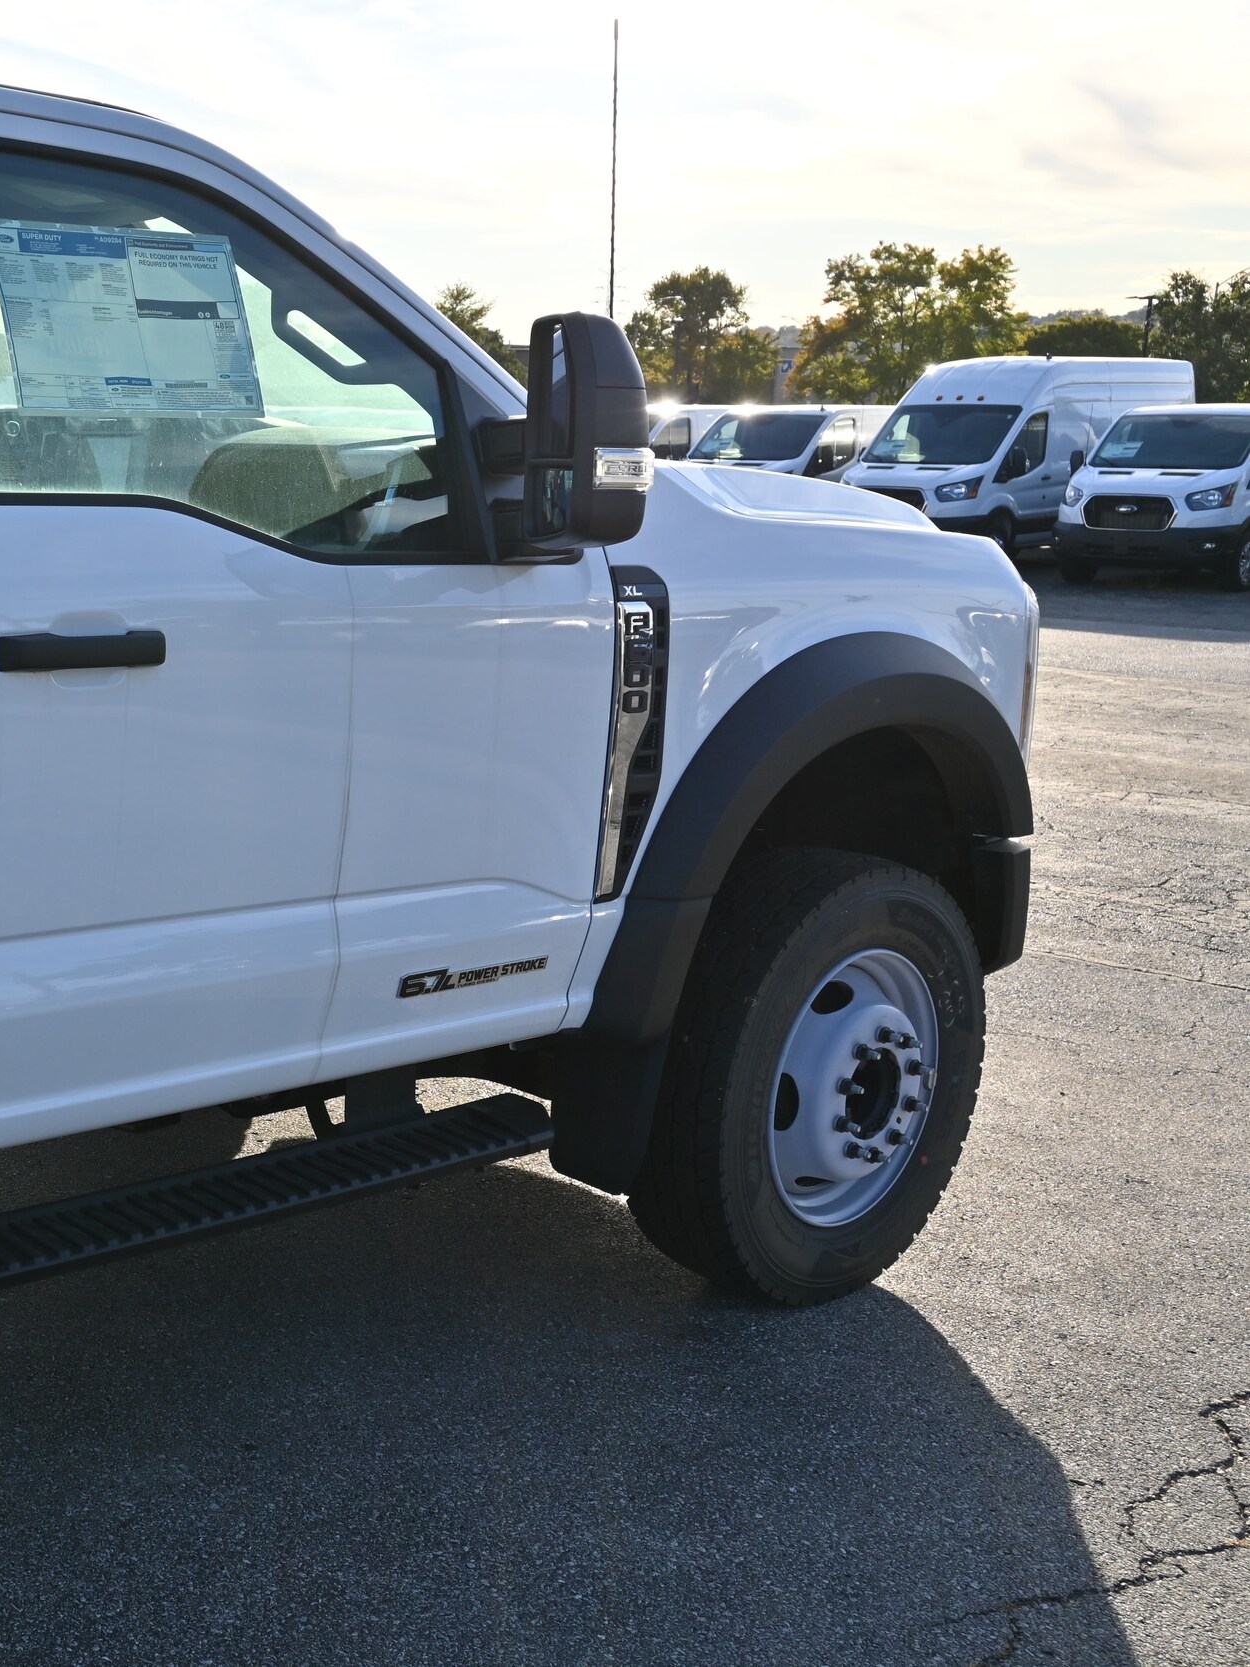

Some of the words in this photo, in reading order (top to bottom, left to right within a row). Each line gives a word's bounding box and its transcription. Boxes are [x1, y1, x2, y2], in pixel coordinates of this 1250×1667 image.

[21, 232, 43, 241] SUPER
[134, 251, 149, 259] FUEL
[149, 253, 178, 261] ECONOMY
[138, 260, 167, 268] REQUIRED
[622, 585, 643, 597] XL
[399, 968, 455, 998] 6.7L
[457, 965, 500, 984] POWER
[500, 957, 547, 976] STROKE
